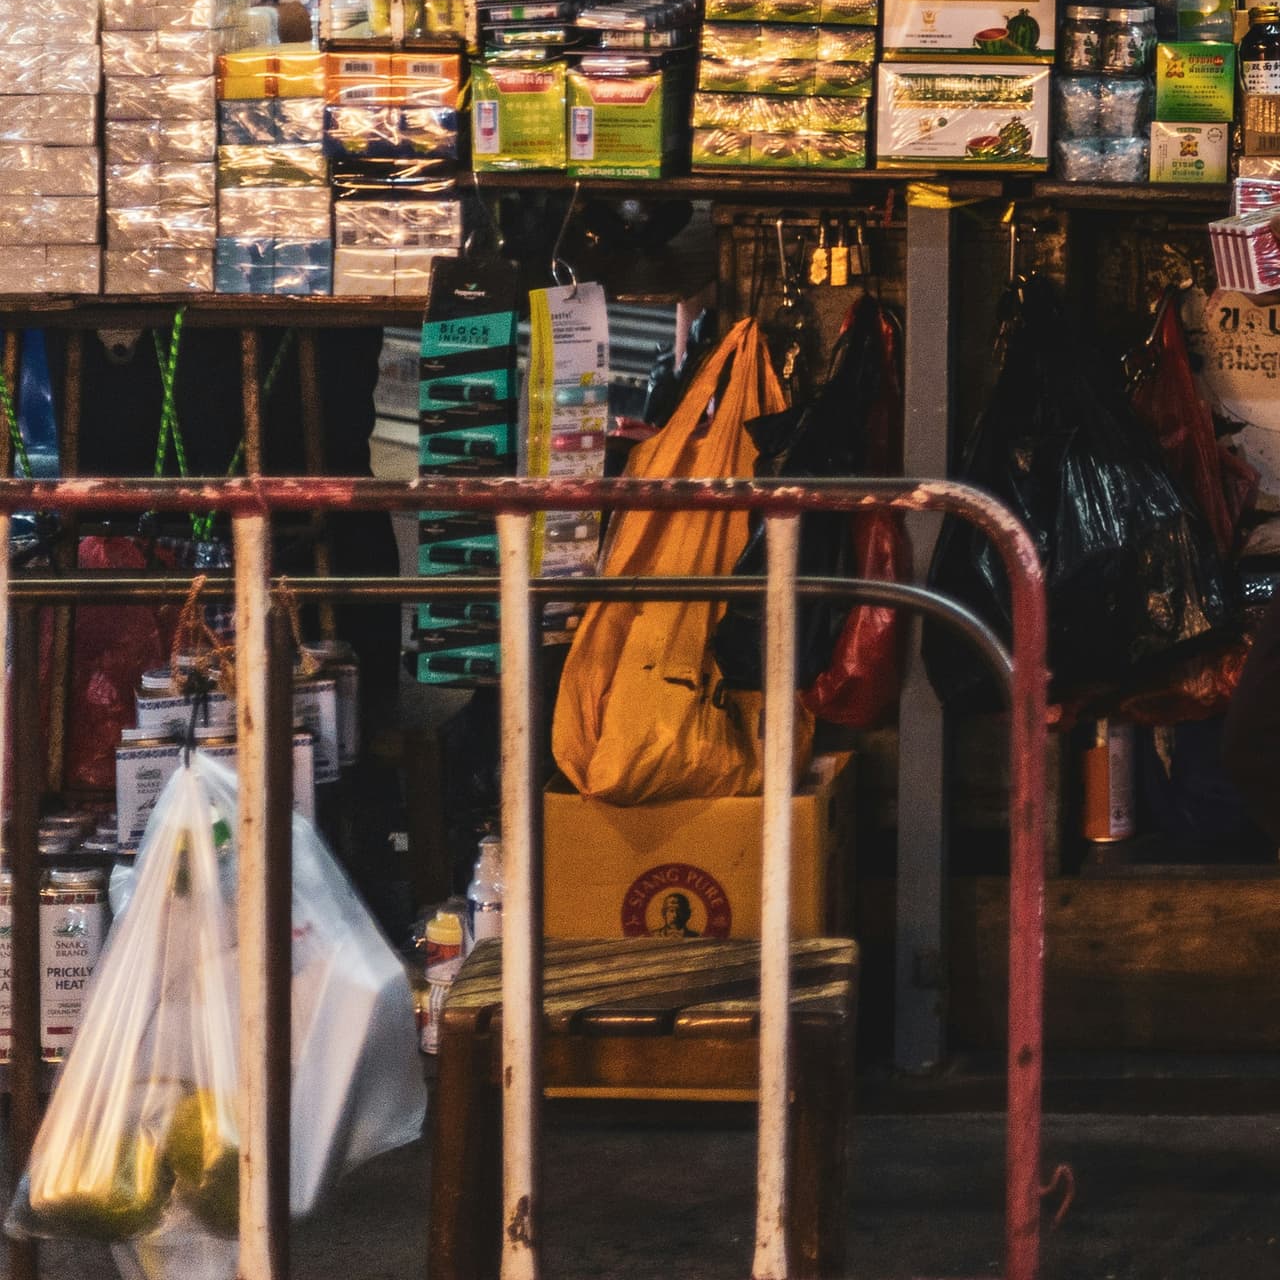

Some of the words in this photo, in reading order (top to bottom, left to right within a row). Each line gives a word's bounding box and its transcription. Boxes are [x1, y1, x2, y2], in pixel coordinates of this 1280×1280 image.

[439, 322, 491, 337] Black
[631, 866, 680, 908] SIANG
[686, 867, 722, 907] PURE
[55, 941, 88, 949] SNAKE
[56, 949, 89, 957] BRAND
[47, 967, 94, 979] PRICKLY
[55, 979, 85, 990] HEAT
